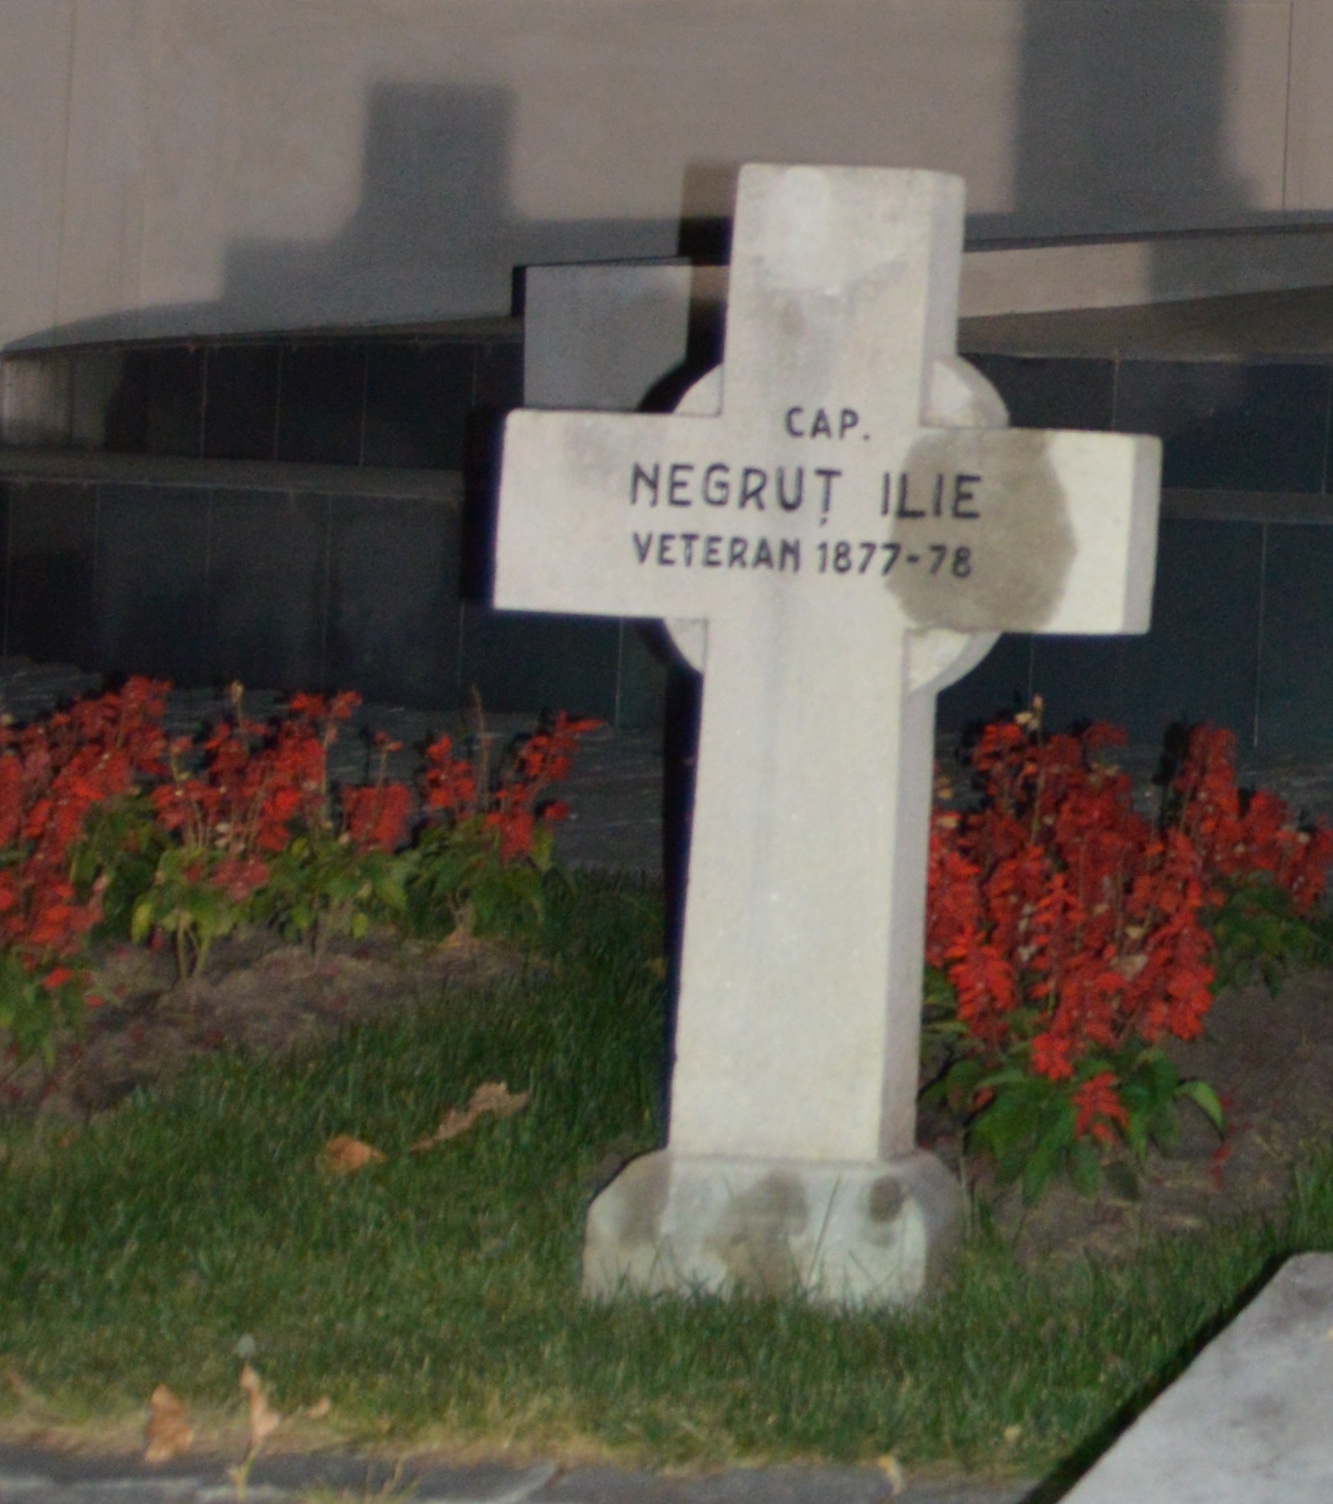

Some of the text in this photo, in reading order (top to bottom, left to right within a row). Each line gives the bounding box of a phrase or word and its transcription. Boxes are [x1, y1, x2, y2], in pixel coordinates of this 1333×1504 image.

[783, 405, 872, 443] CAP.
[627, 462, 983, 526] NEGRUȚ ILIE
[631, 532, 801, 574] VETERAN
